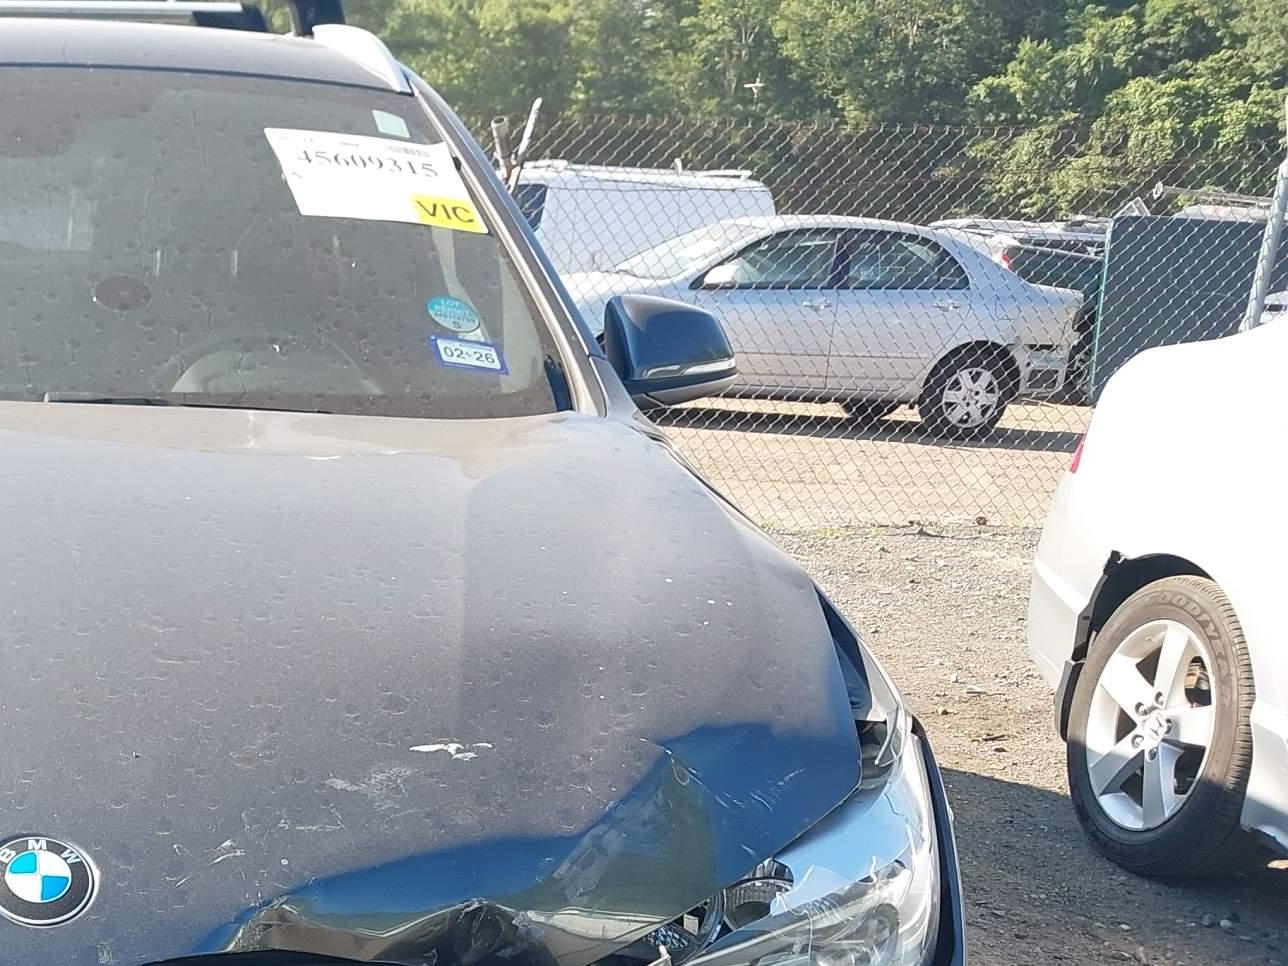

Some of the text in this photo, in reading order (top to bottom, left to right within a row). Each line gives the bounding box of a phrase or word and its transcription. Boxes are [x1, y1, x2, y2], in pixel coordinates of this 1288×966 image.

[297, 149, 439, 179] 45609315
[415, 199, 475, 224] VIC
[1145, 590, 1232, 708] GOODYEAR
